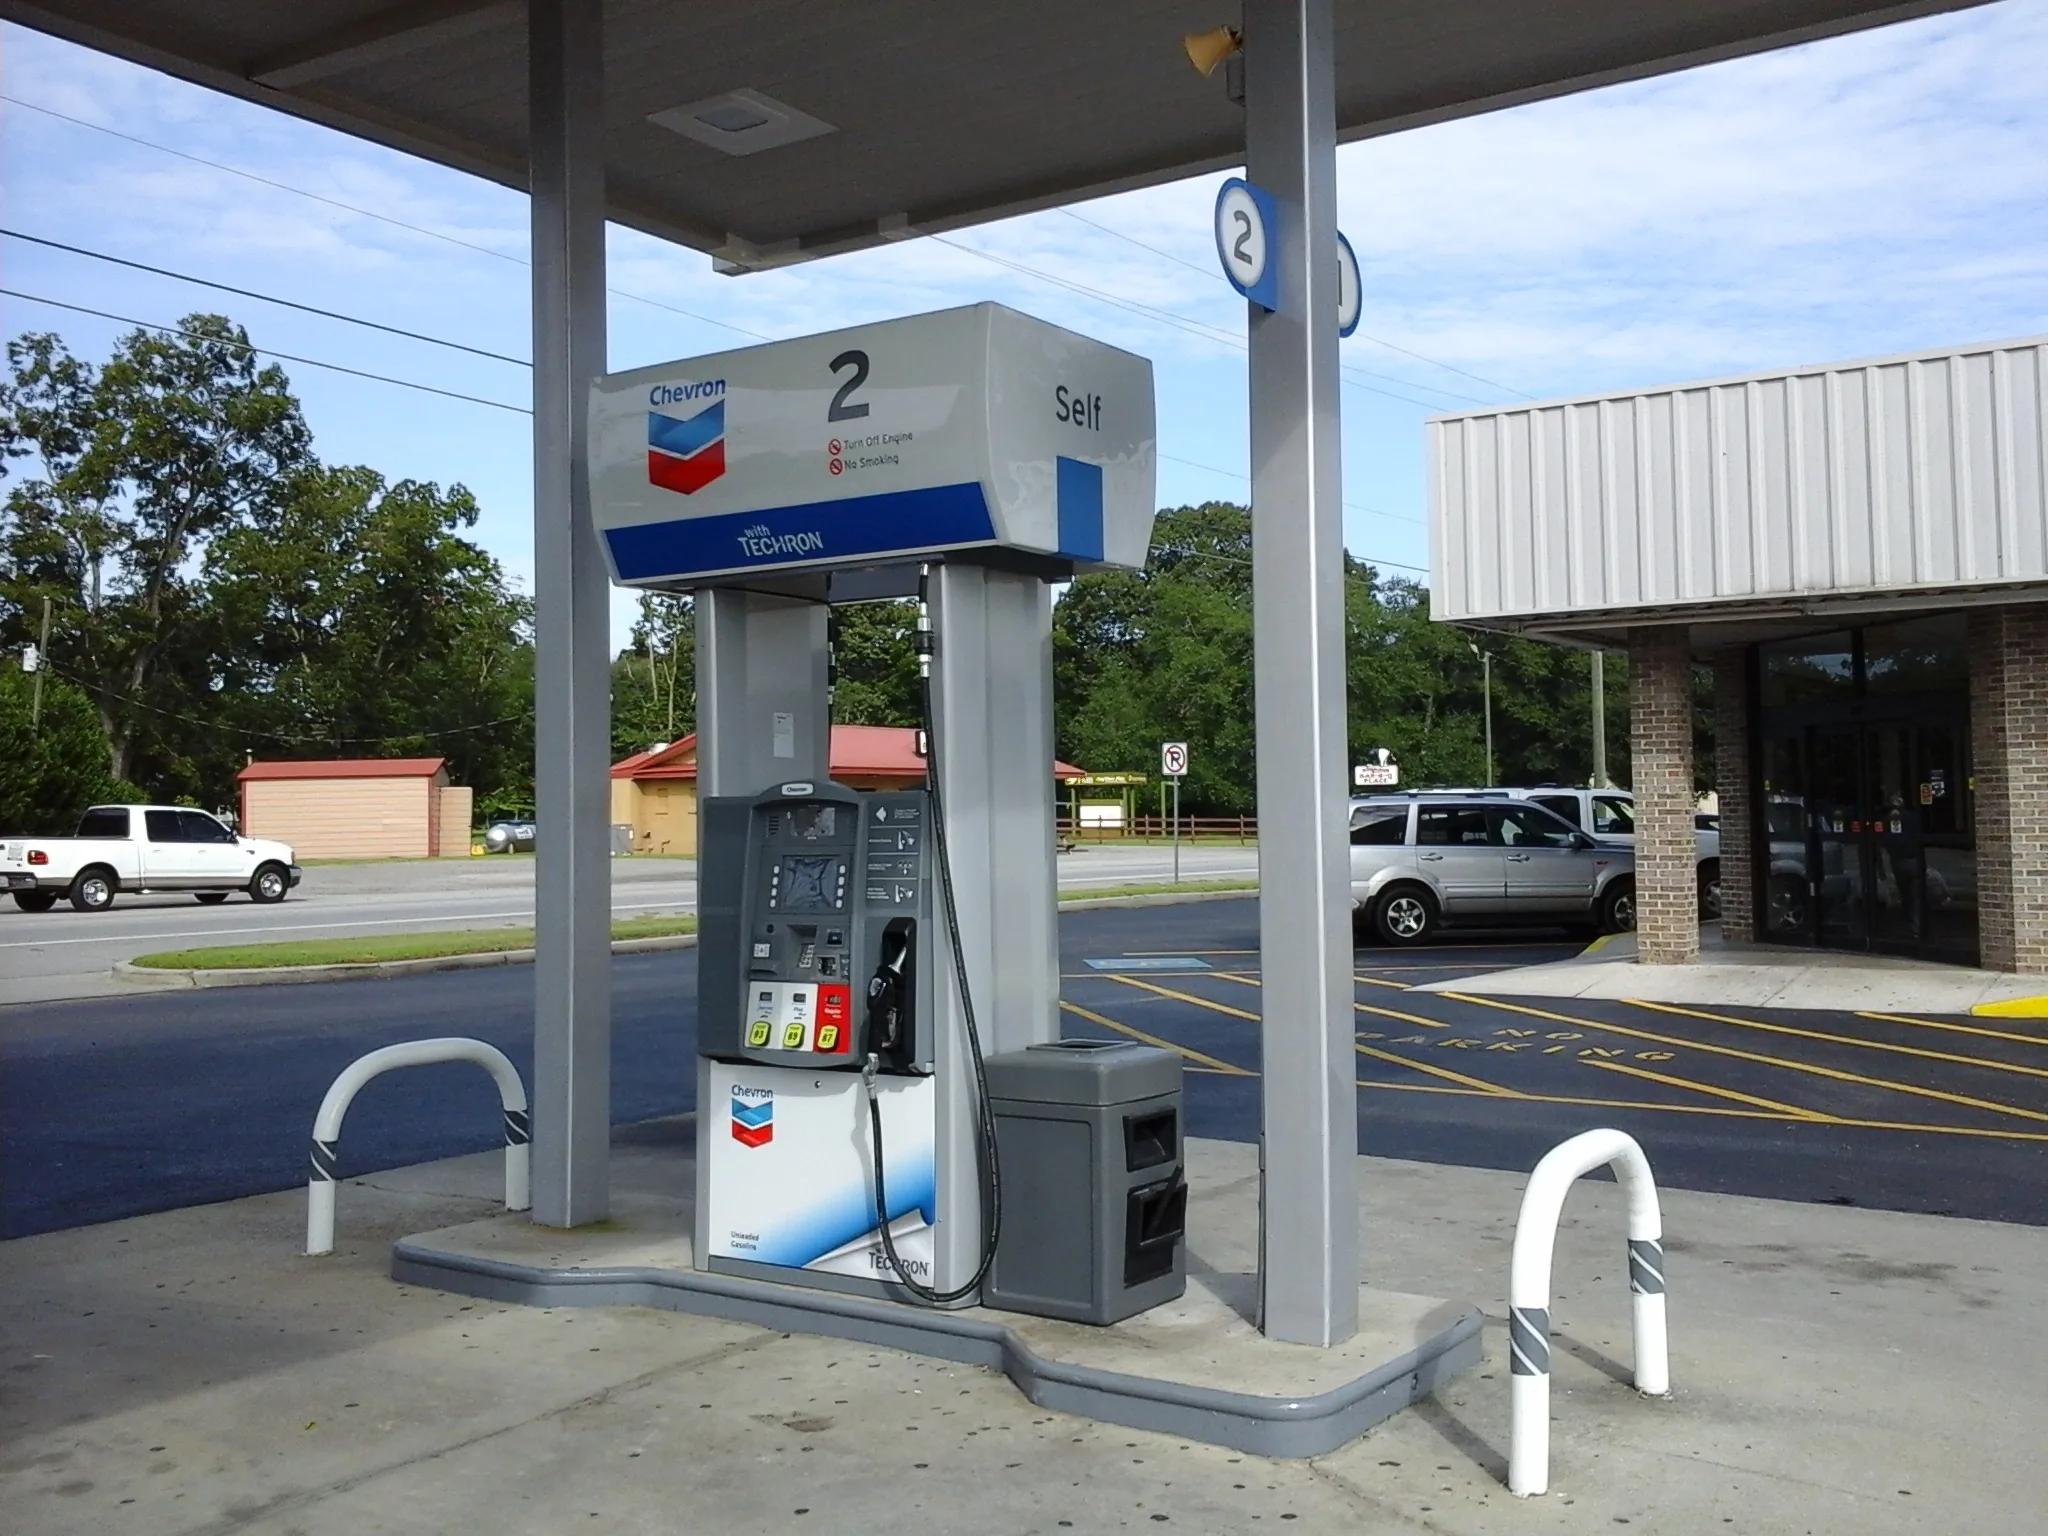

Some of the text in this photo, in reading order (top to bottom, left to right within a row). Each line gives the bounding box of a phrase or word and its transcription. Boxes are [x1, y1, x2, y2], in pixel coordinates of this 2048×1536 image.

[1233, 209, 1253, 266] 2
[649, 377, 727, 406] Chevron
[827, 349, 870, 423] 2
[1055, 384, 1101, 432] Self
[843, 432, 913, 450] Turn Off Engine
[844, 454, 899, 470] No Smoking
[744, 523, 771, 538] with
[737, 531, 823, 559] TECHRON
[1492, 1028, 1584, 1041] NO
[1355, 1031, 1677, 1062] PARKING
[731, 1084, 774, 1099] Chevron
[730, 1230, 760, 1241] Unleaded
[730, 1240, 757, 1251] Gasoline
[868, 1251, 929, 1277] TECRON
